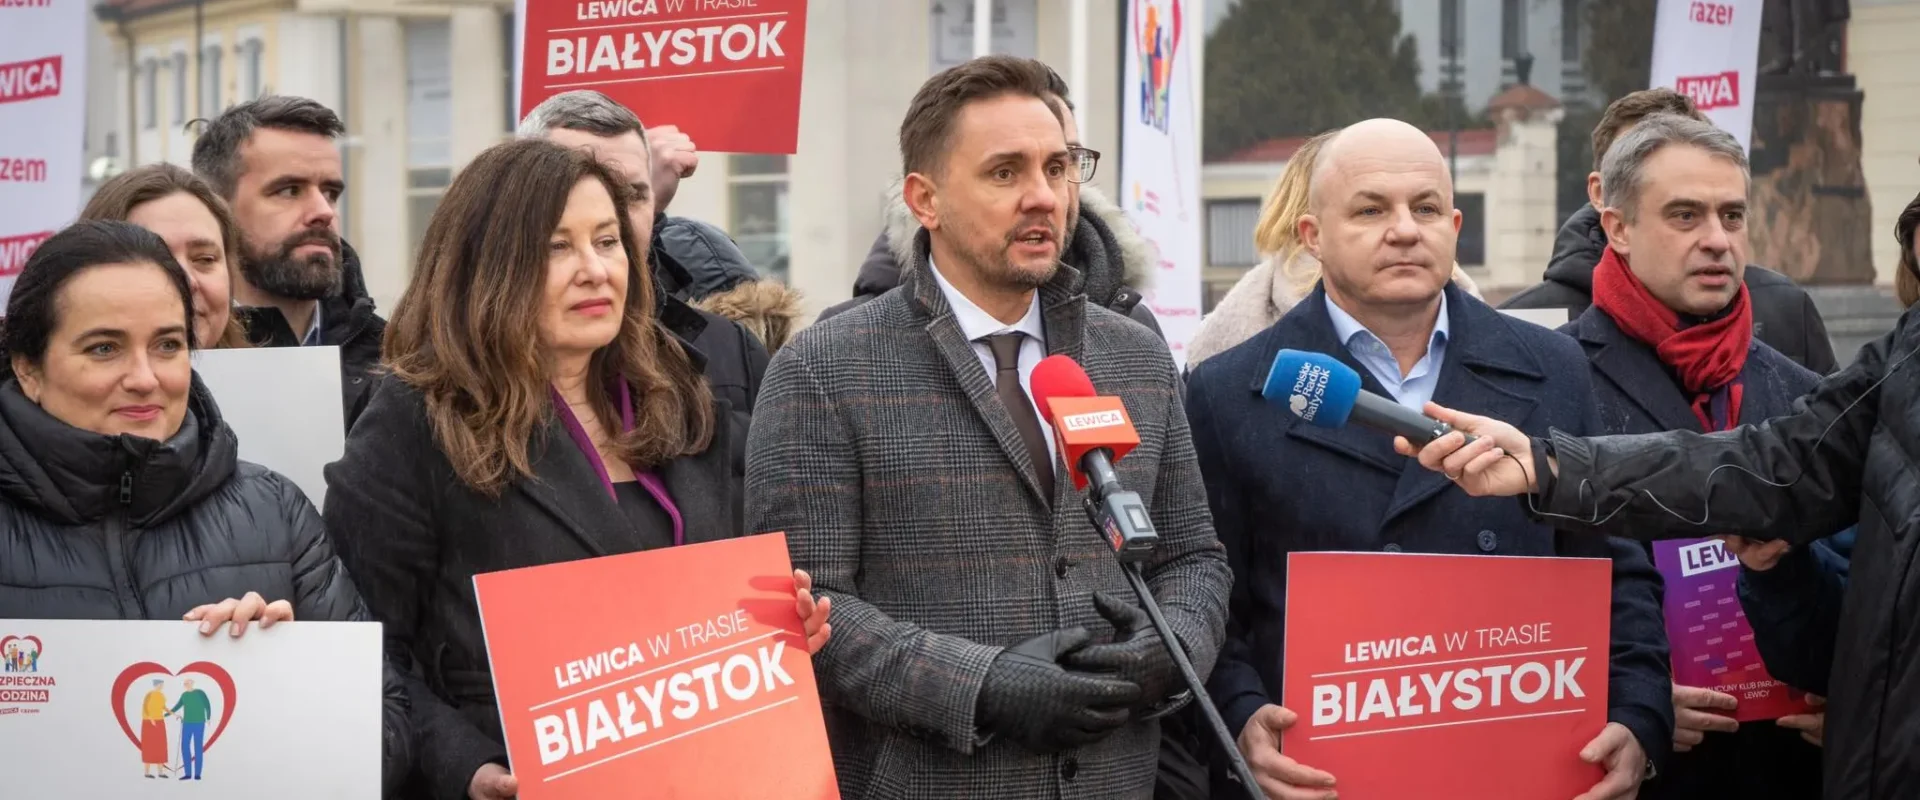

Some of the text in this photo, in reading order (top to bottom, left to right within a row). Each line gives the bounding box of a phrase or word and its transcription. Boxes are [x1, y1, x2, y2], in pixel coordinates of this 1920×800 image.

[577, 0, 658, 21] LEWICA
[664, 0, 684, 13] W
[546, 21, 787, 76] BIAŁYSTOK
[1293, 362, 1312, 393] Polskie
[1303, 365, 1321, 397] Radio
[1068, 412, 1121, 428] LEWICA
[554, 609, 749, 689] LEWICA W TRASIE
[1344, 622, 1552, 663] LEWICA W TRASIE
[0, 690, 48, 701] ODZINA
[1312, 657, 1587, 726] BIAŁYSTOK
[1739, 681, 1757, 691] KLUB
[1744, 690, 1770, 700] LEWICY
[533, 640, 795, 766] BIAŁYSTOK
